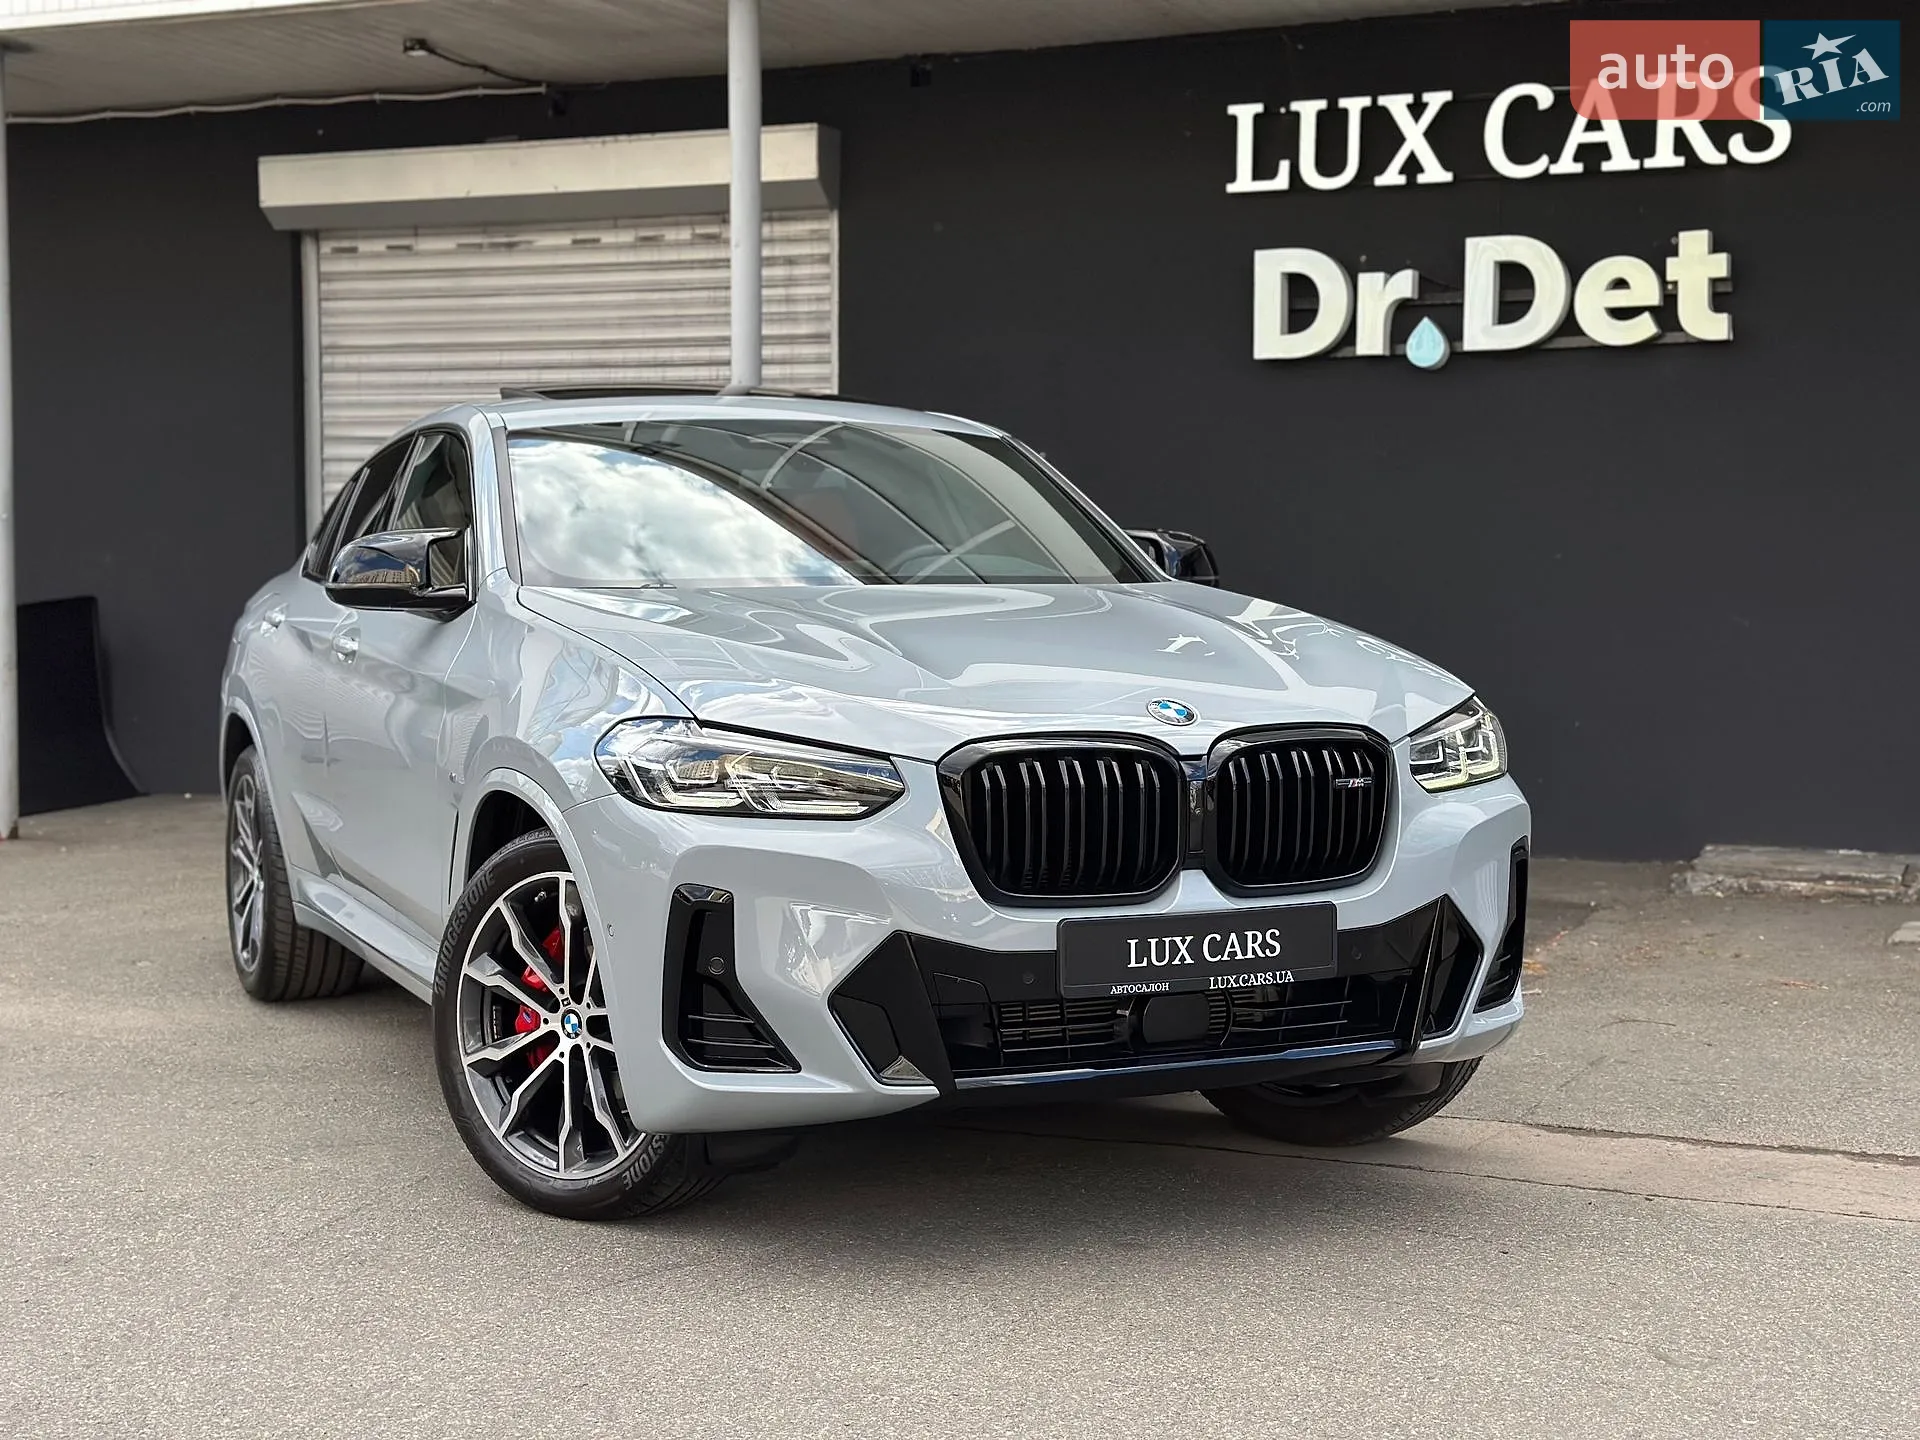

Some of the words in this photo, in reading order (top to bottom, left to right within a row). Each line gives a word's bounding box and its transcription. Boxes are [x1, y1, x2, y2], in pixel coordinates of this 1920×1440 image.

[1226, 90, 1453, 193] LUX
[1484, 65, 1792, 179] CARS
[1463, 229, 1733, 351] Det
[434, 867, 496, 999] BRIDGESTONE
[1110, 982, 1170, 995] АВТОСАЛОН
[1126, 934, 1195, 968] LUX
[1202, 928, 1282, 963] CARS
